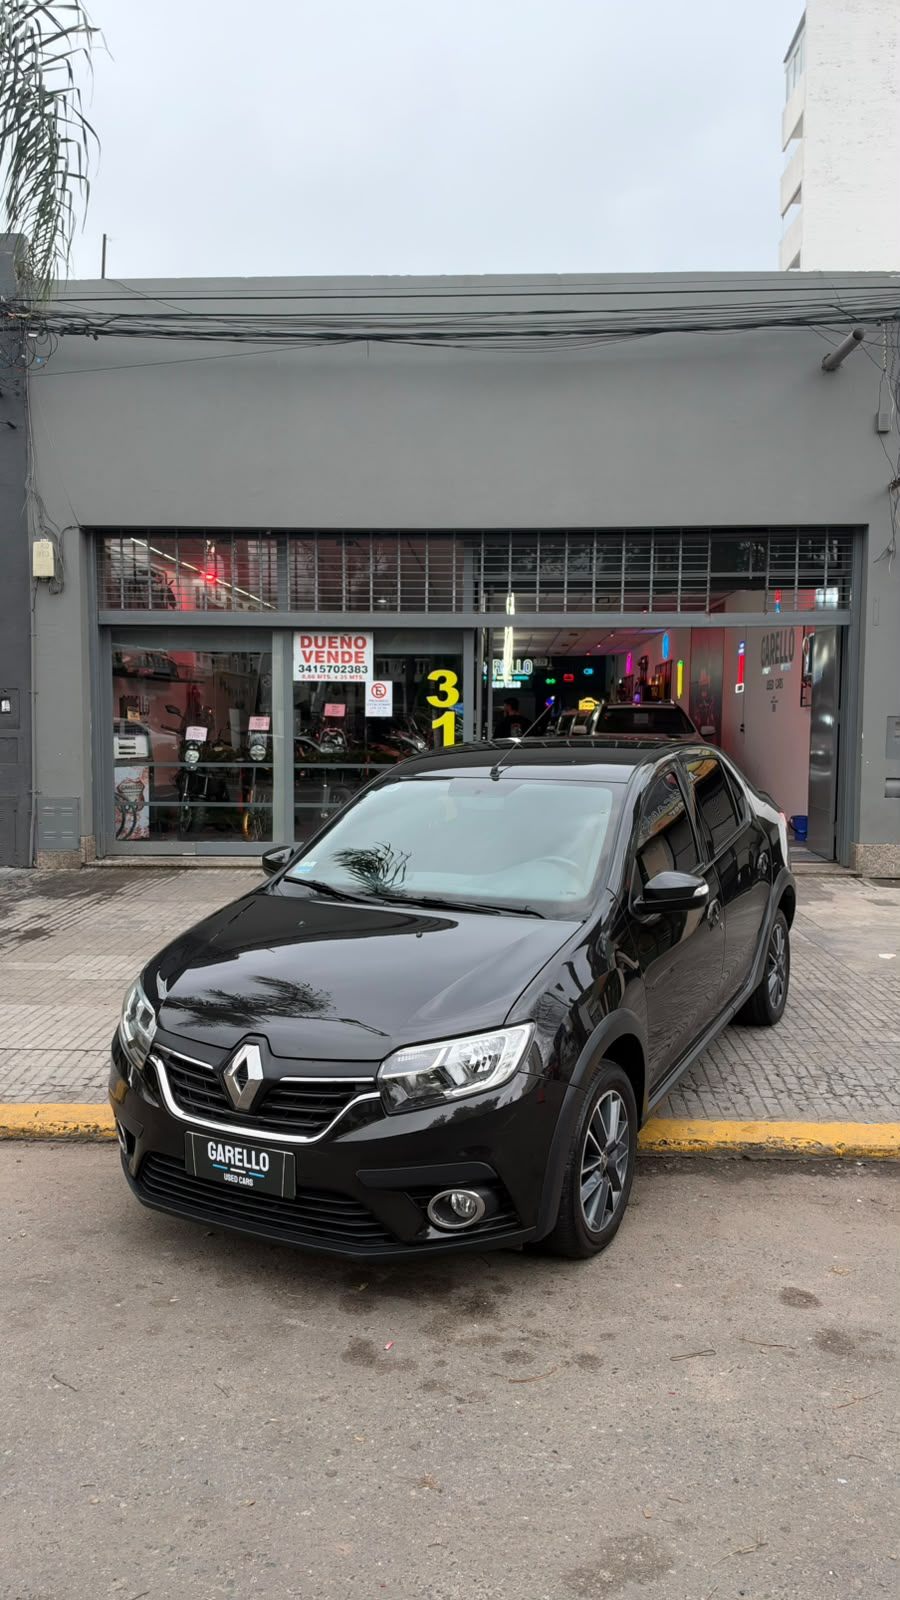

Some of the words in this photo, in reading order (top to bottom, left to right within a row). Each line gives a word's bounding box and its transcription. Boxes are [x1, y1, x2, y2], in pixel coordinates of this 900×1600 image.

[300, 633, 367, 650] DUEÑO
[760, 627, 795, 668] GARELLO
[301, 650, 365, 664] VENDE
[298, 664, 369, 674] 3415702383
[207, 1141, 269, 1172] GARELLO
[224, 1173, 238, 1183] USED
[239, 1177, 254, 1186] CARS
